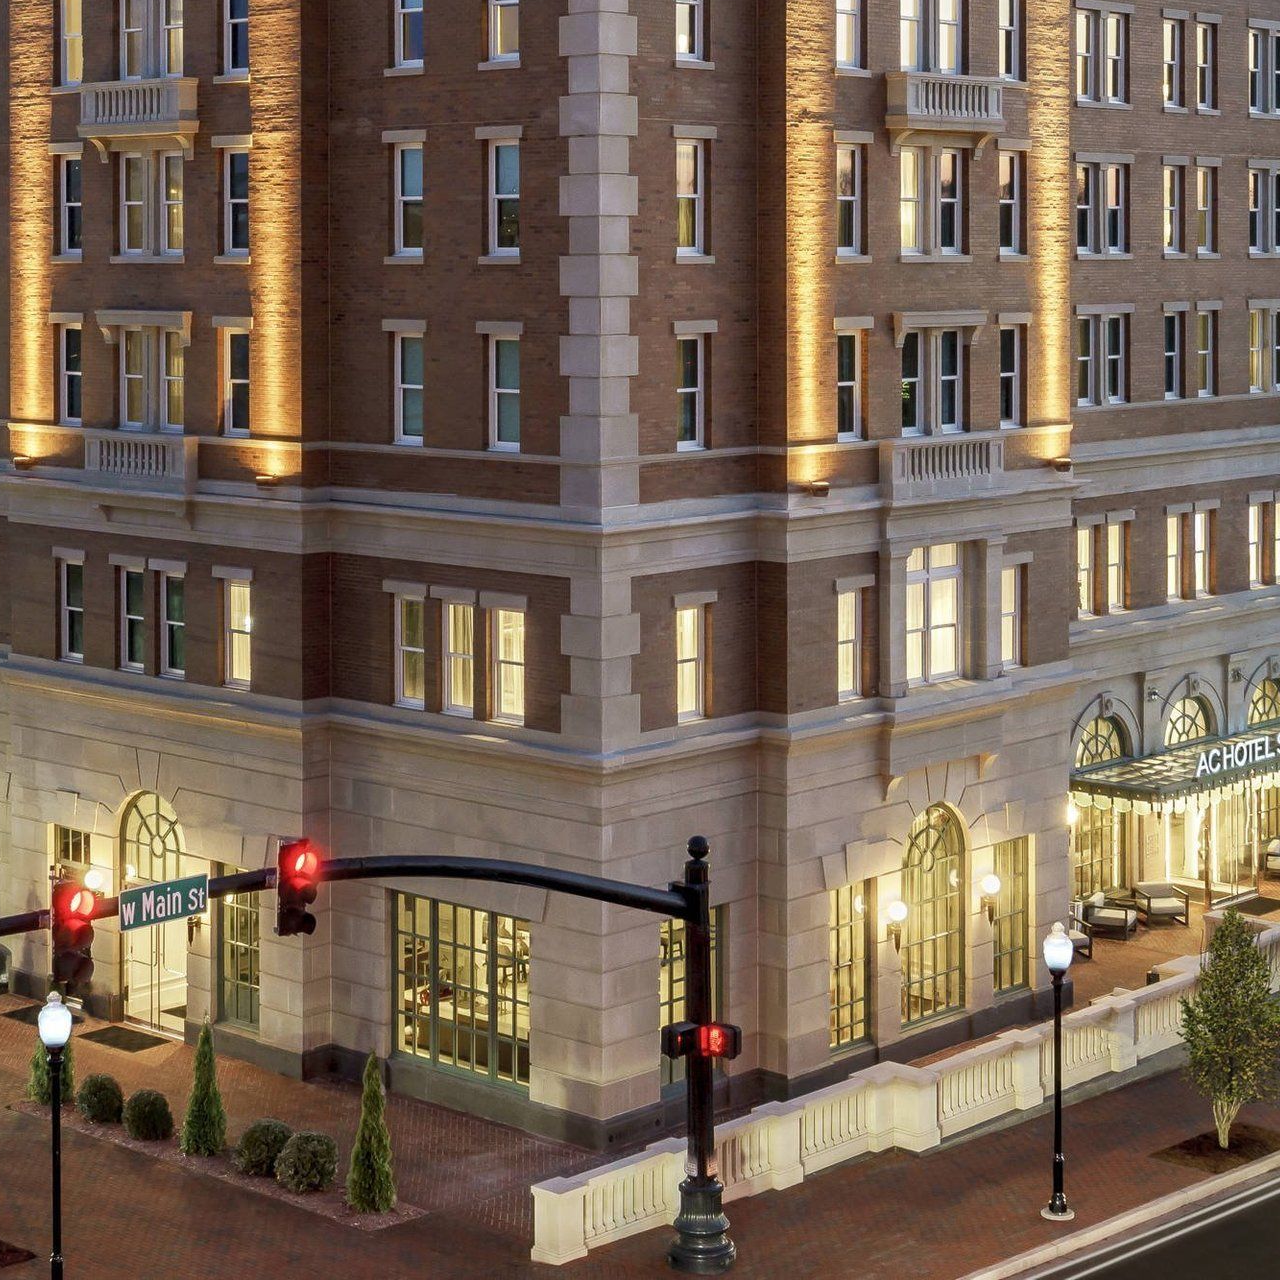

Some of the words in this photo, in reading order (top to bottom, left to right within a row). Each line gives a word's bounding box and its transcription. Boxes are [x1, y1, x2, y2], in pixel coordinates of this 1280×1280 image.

[1196, 749, 1221, 777] AC
[1222, 736, 1275, 769] HOTEL
[122, 902, 135, 926] W
[142, 887, 182, 922] Main
[188, 887, 205, 911] St
